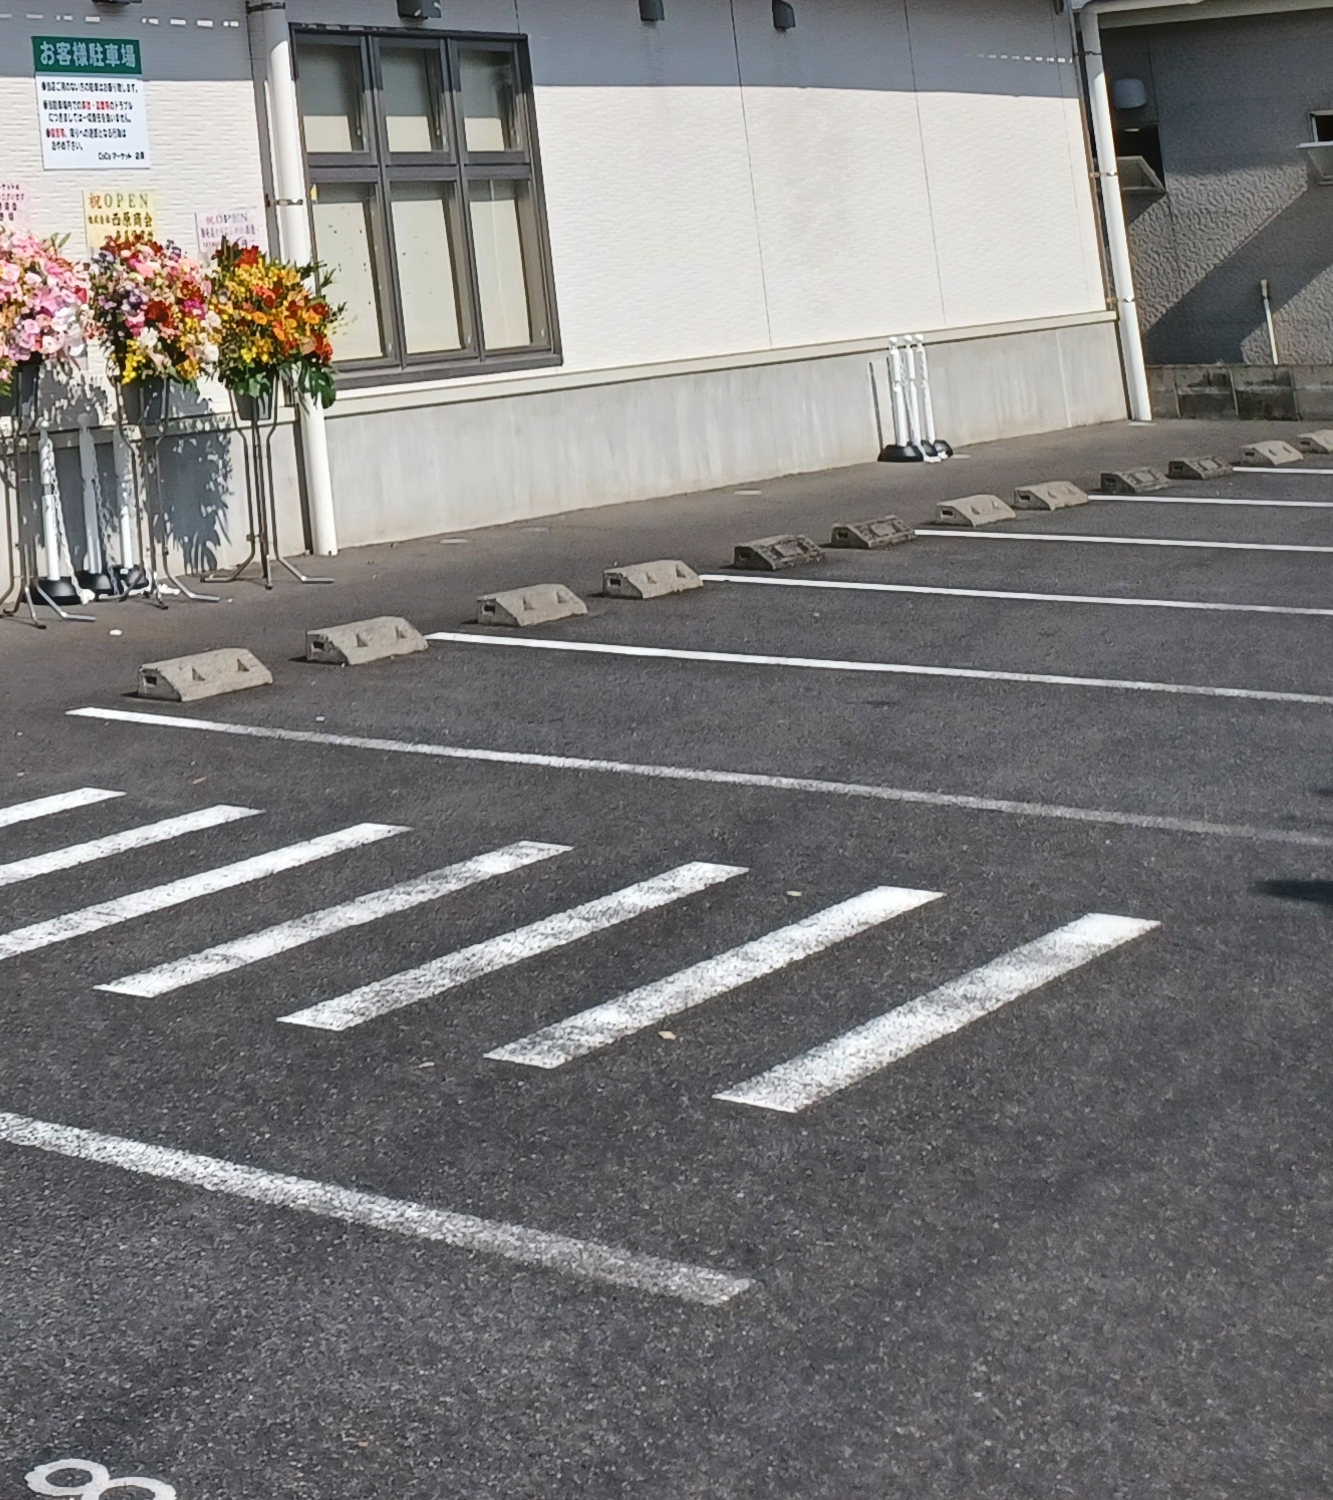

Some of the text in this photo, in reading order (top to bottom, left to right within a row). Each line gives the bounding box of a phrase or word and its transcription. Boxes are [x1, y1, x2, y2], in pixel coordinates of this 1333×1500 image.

[39, 41, 136, 68] お客様駐車場
